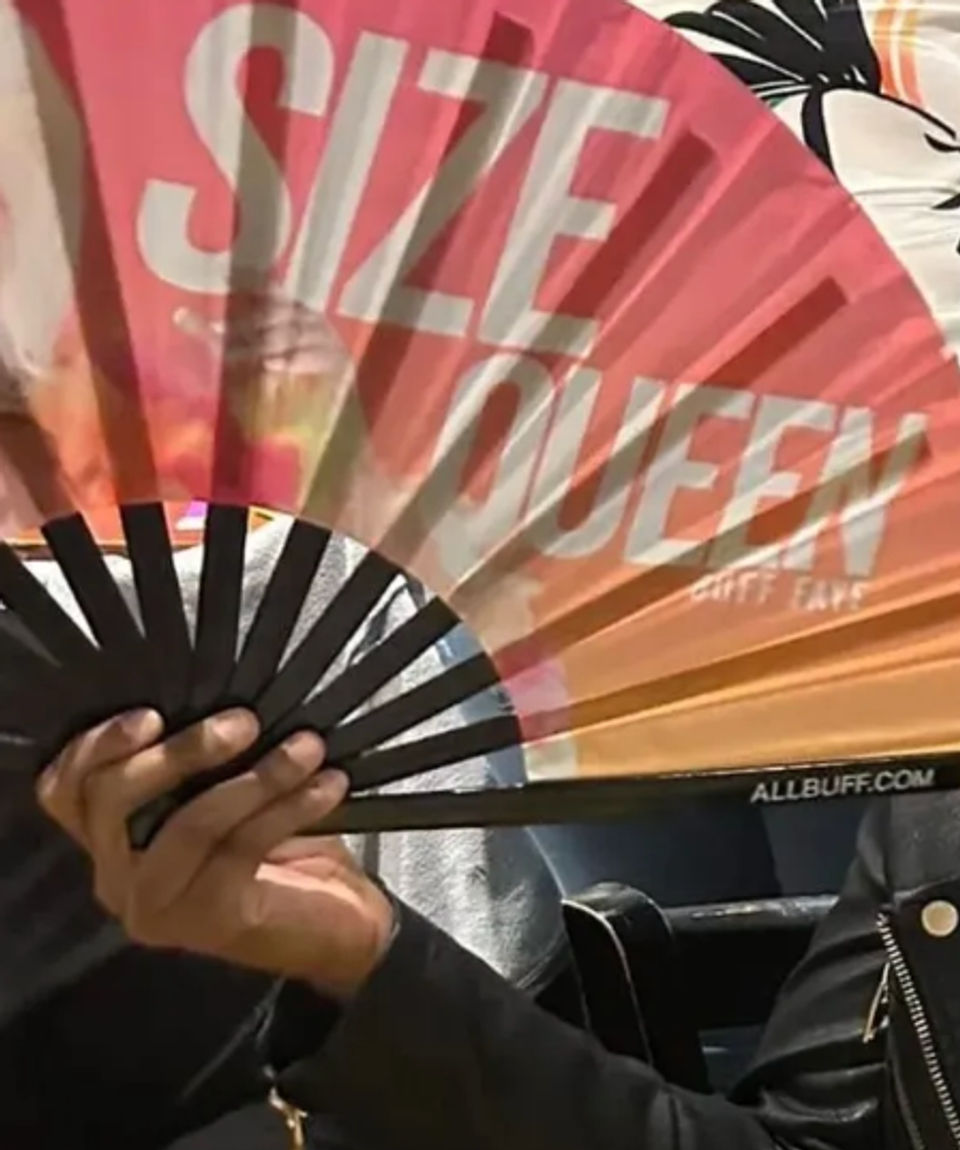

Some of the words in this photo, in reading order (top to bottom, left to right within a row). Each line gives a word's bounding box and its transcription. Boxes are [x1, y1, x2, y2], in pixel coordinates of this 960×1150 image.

[137, 3, 669, 354] SIZE
[438, 355, 930, 579] QUEEN
[792, 578, 870, 610] FAYE
[750, 768, 935, 803] ALLBUFF.COM
